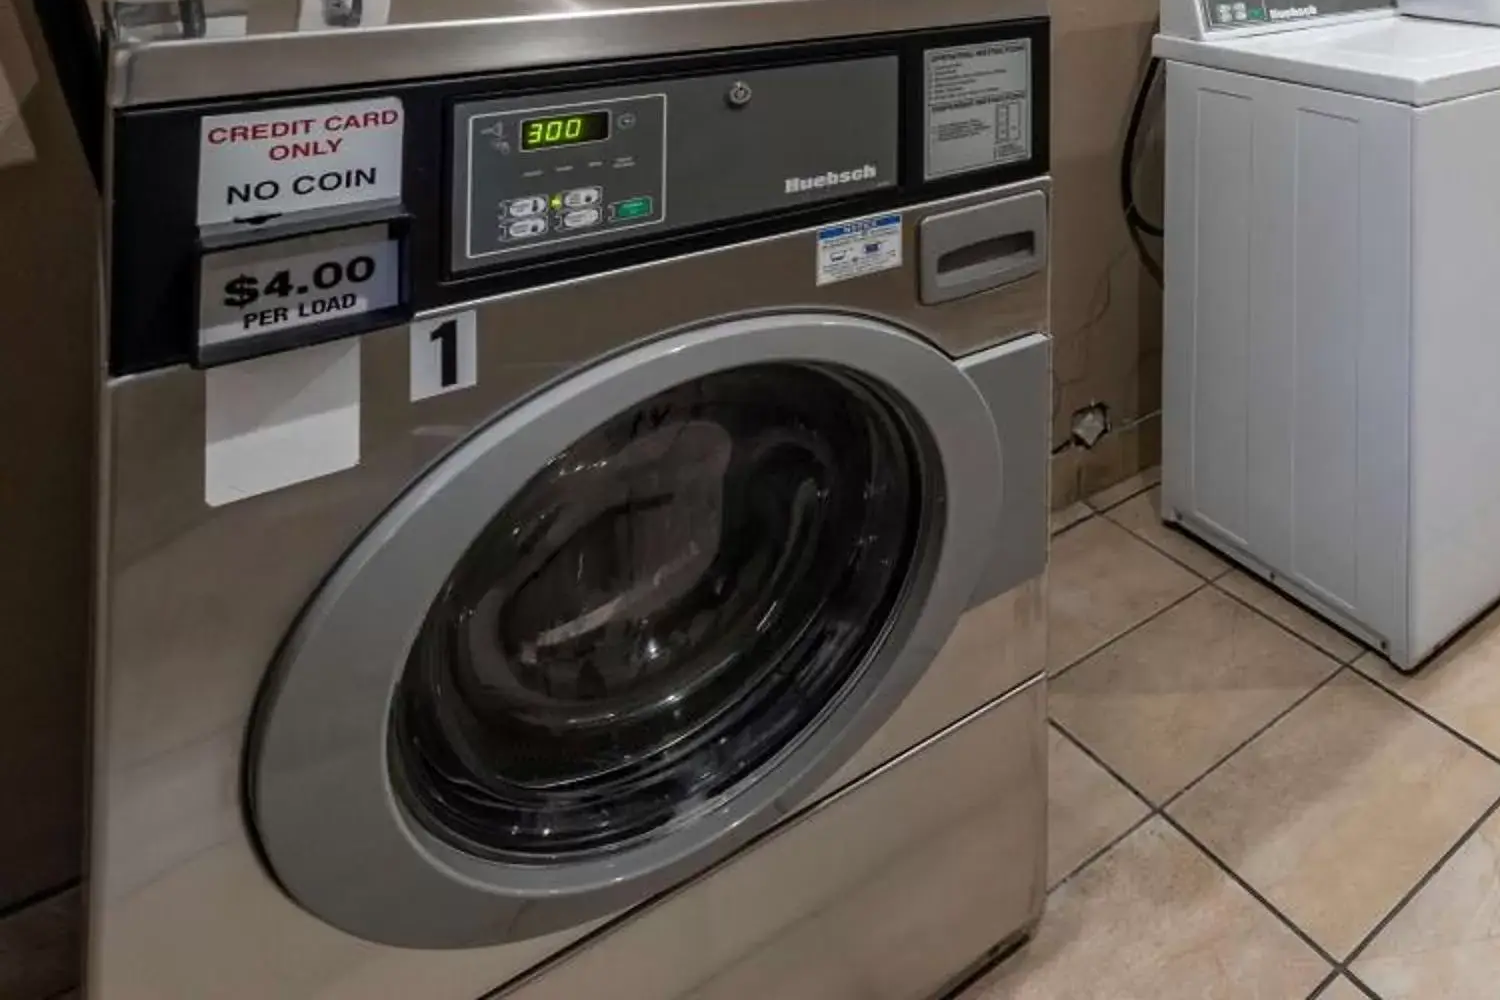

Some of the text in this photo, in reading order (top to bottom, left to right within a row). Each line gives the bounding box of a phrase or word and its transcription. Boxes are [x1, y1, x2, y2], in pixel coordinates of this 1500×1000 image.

[207, 109, 399, 145] CREDIT CARD
[527, 118, 582, 144] 300
[269, 137, 344, 161] ONLY
[226, 167, 377, 205] NO COIN
[784, 164, 877, 194] Huebsch
[223, 255, 376, 309] $4.00
[243, 292, 358, 329] PER LOAD
[430, 319, 458, 388] 1
